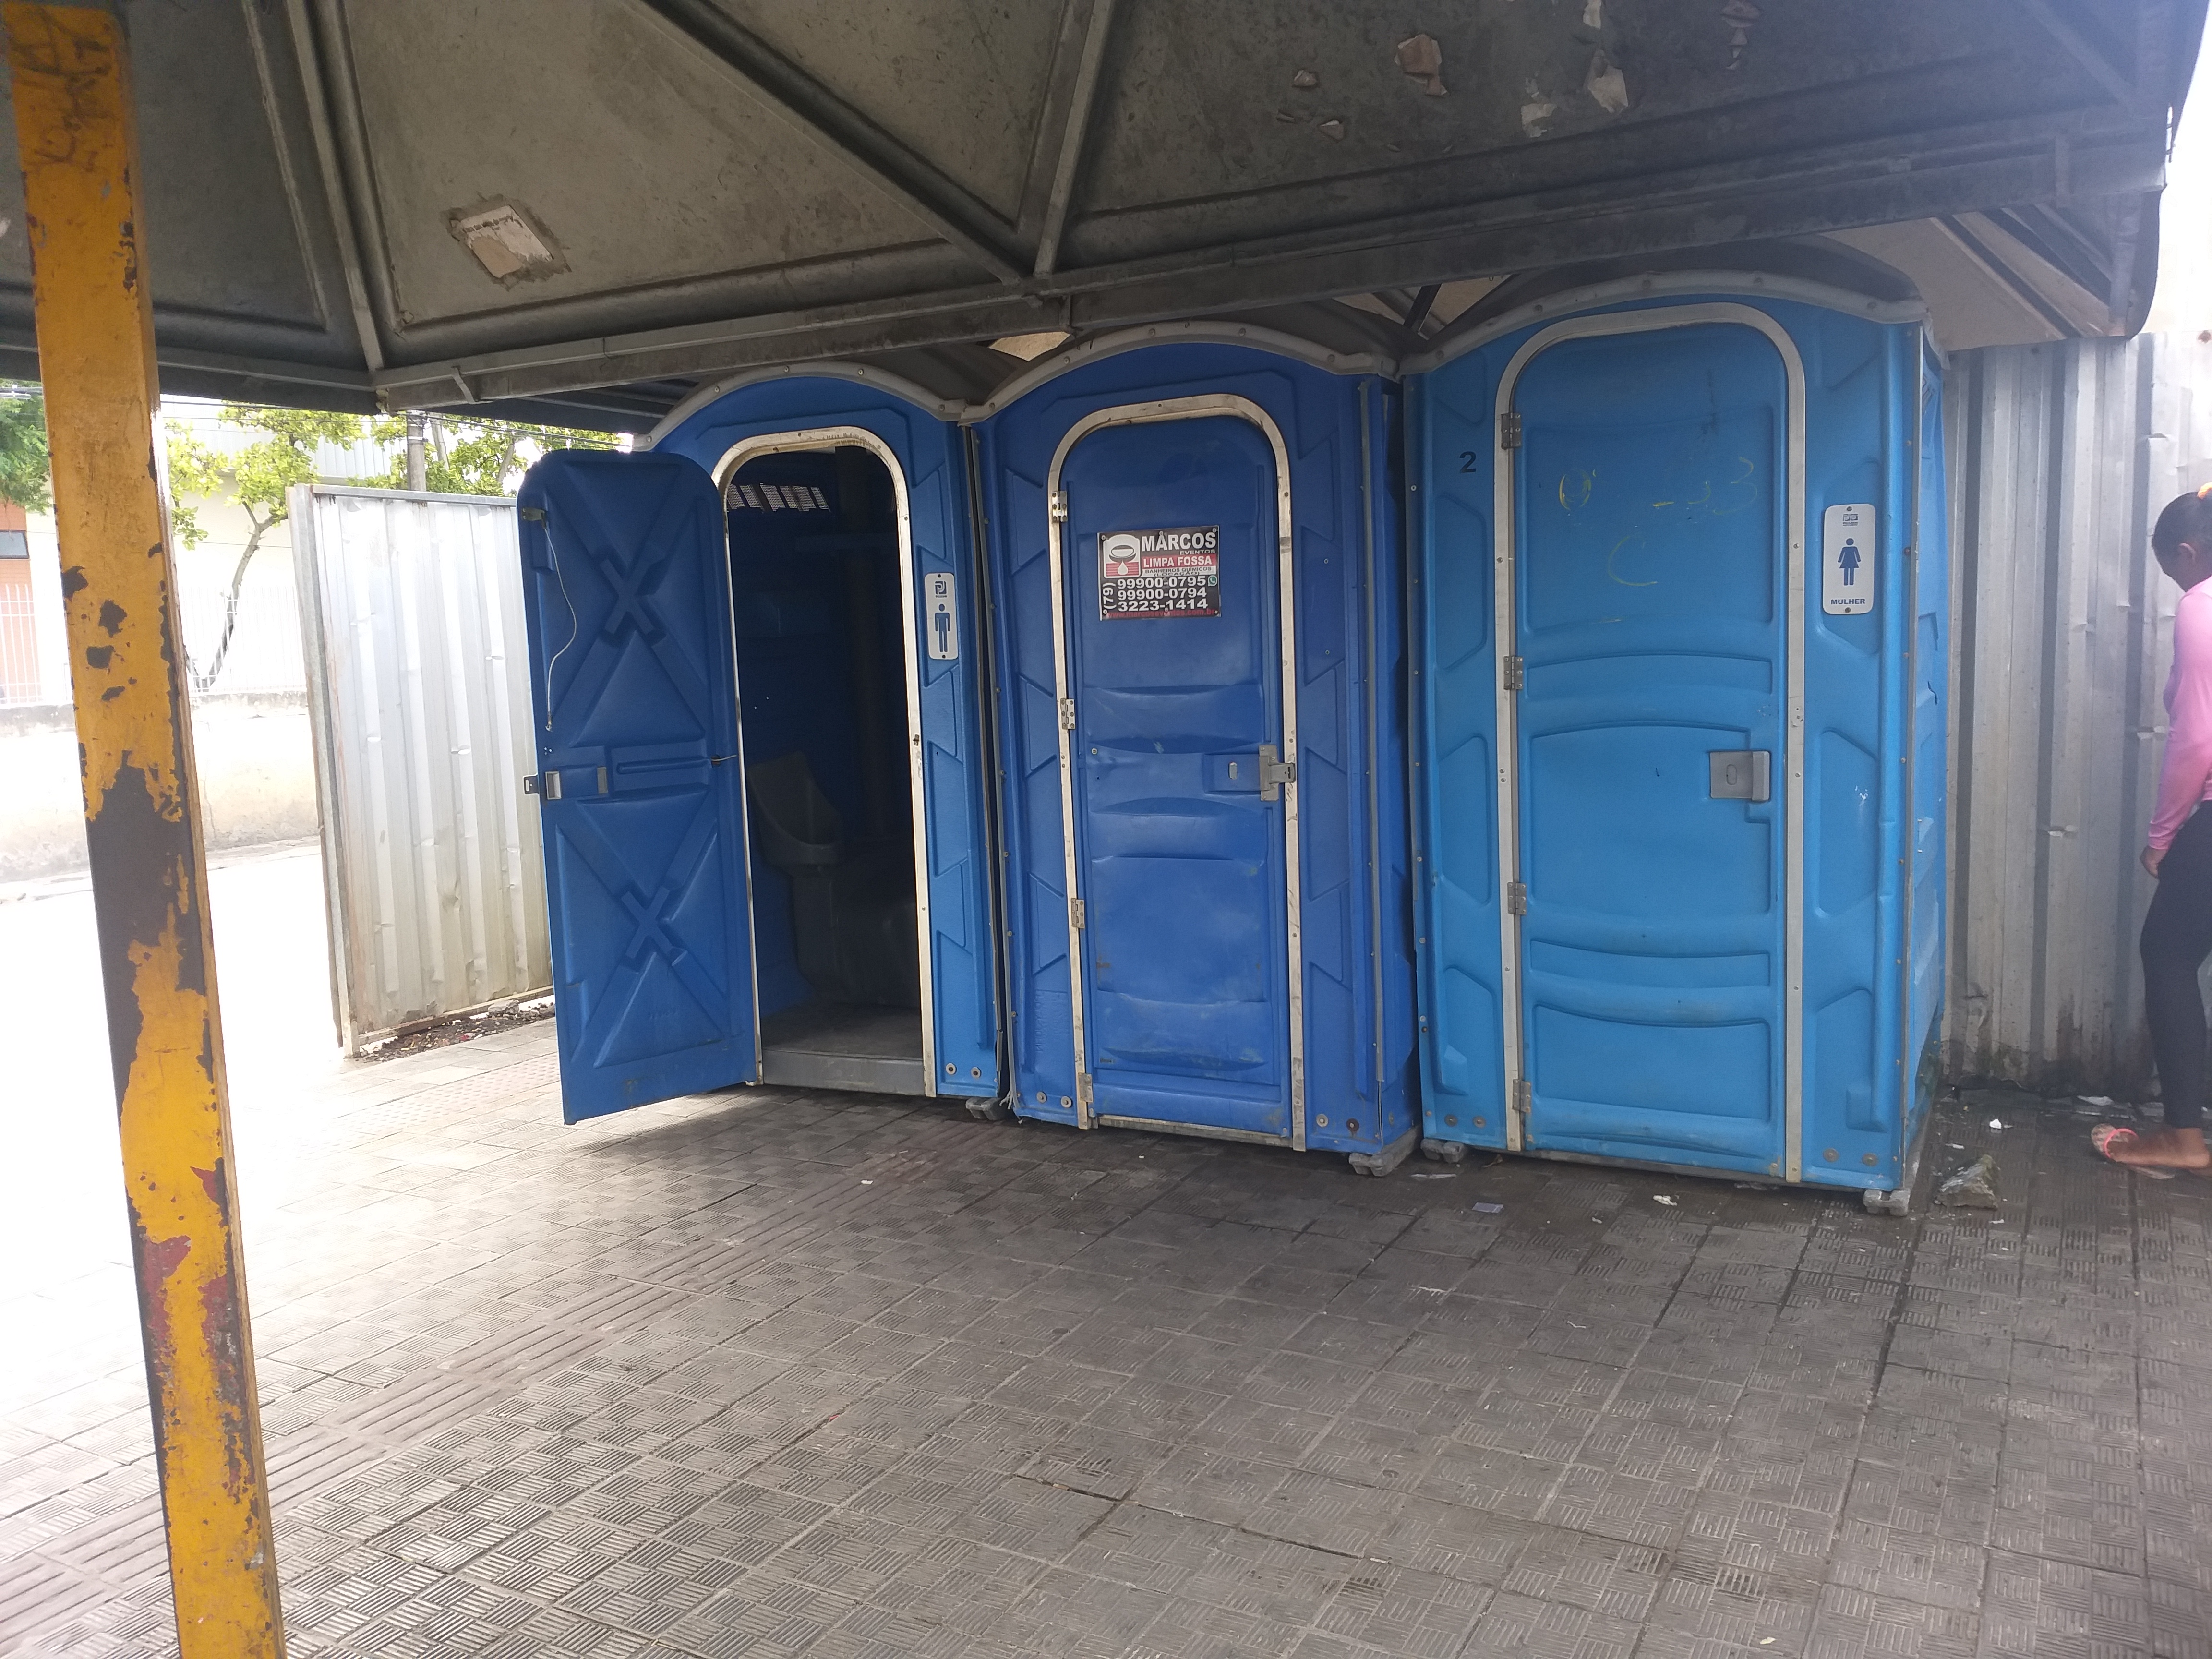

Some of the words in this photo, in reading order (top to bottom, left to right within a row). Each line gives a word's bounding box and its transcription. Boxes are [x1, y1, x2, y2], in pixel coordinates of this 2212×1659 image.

[1459, 451, 1477, 474] 2
[1142, 532, 1216, 552] MARCOS
[1143, 557, 1175, 568] LIMPA
[1178, 555, 1212, 566] FOSSA
[1117, 576, 1206, 589] 99900-0795
[1102, 582, 1117, 610] (79)
[1118, 587, 1207, 601] 99900-0794
[1118, 598, 1208, 612] 3223-1414
[1106, 608, 1215, 618] www.marcosevntos.com.br
